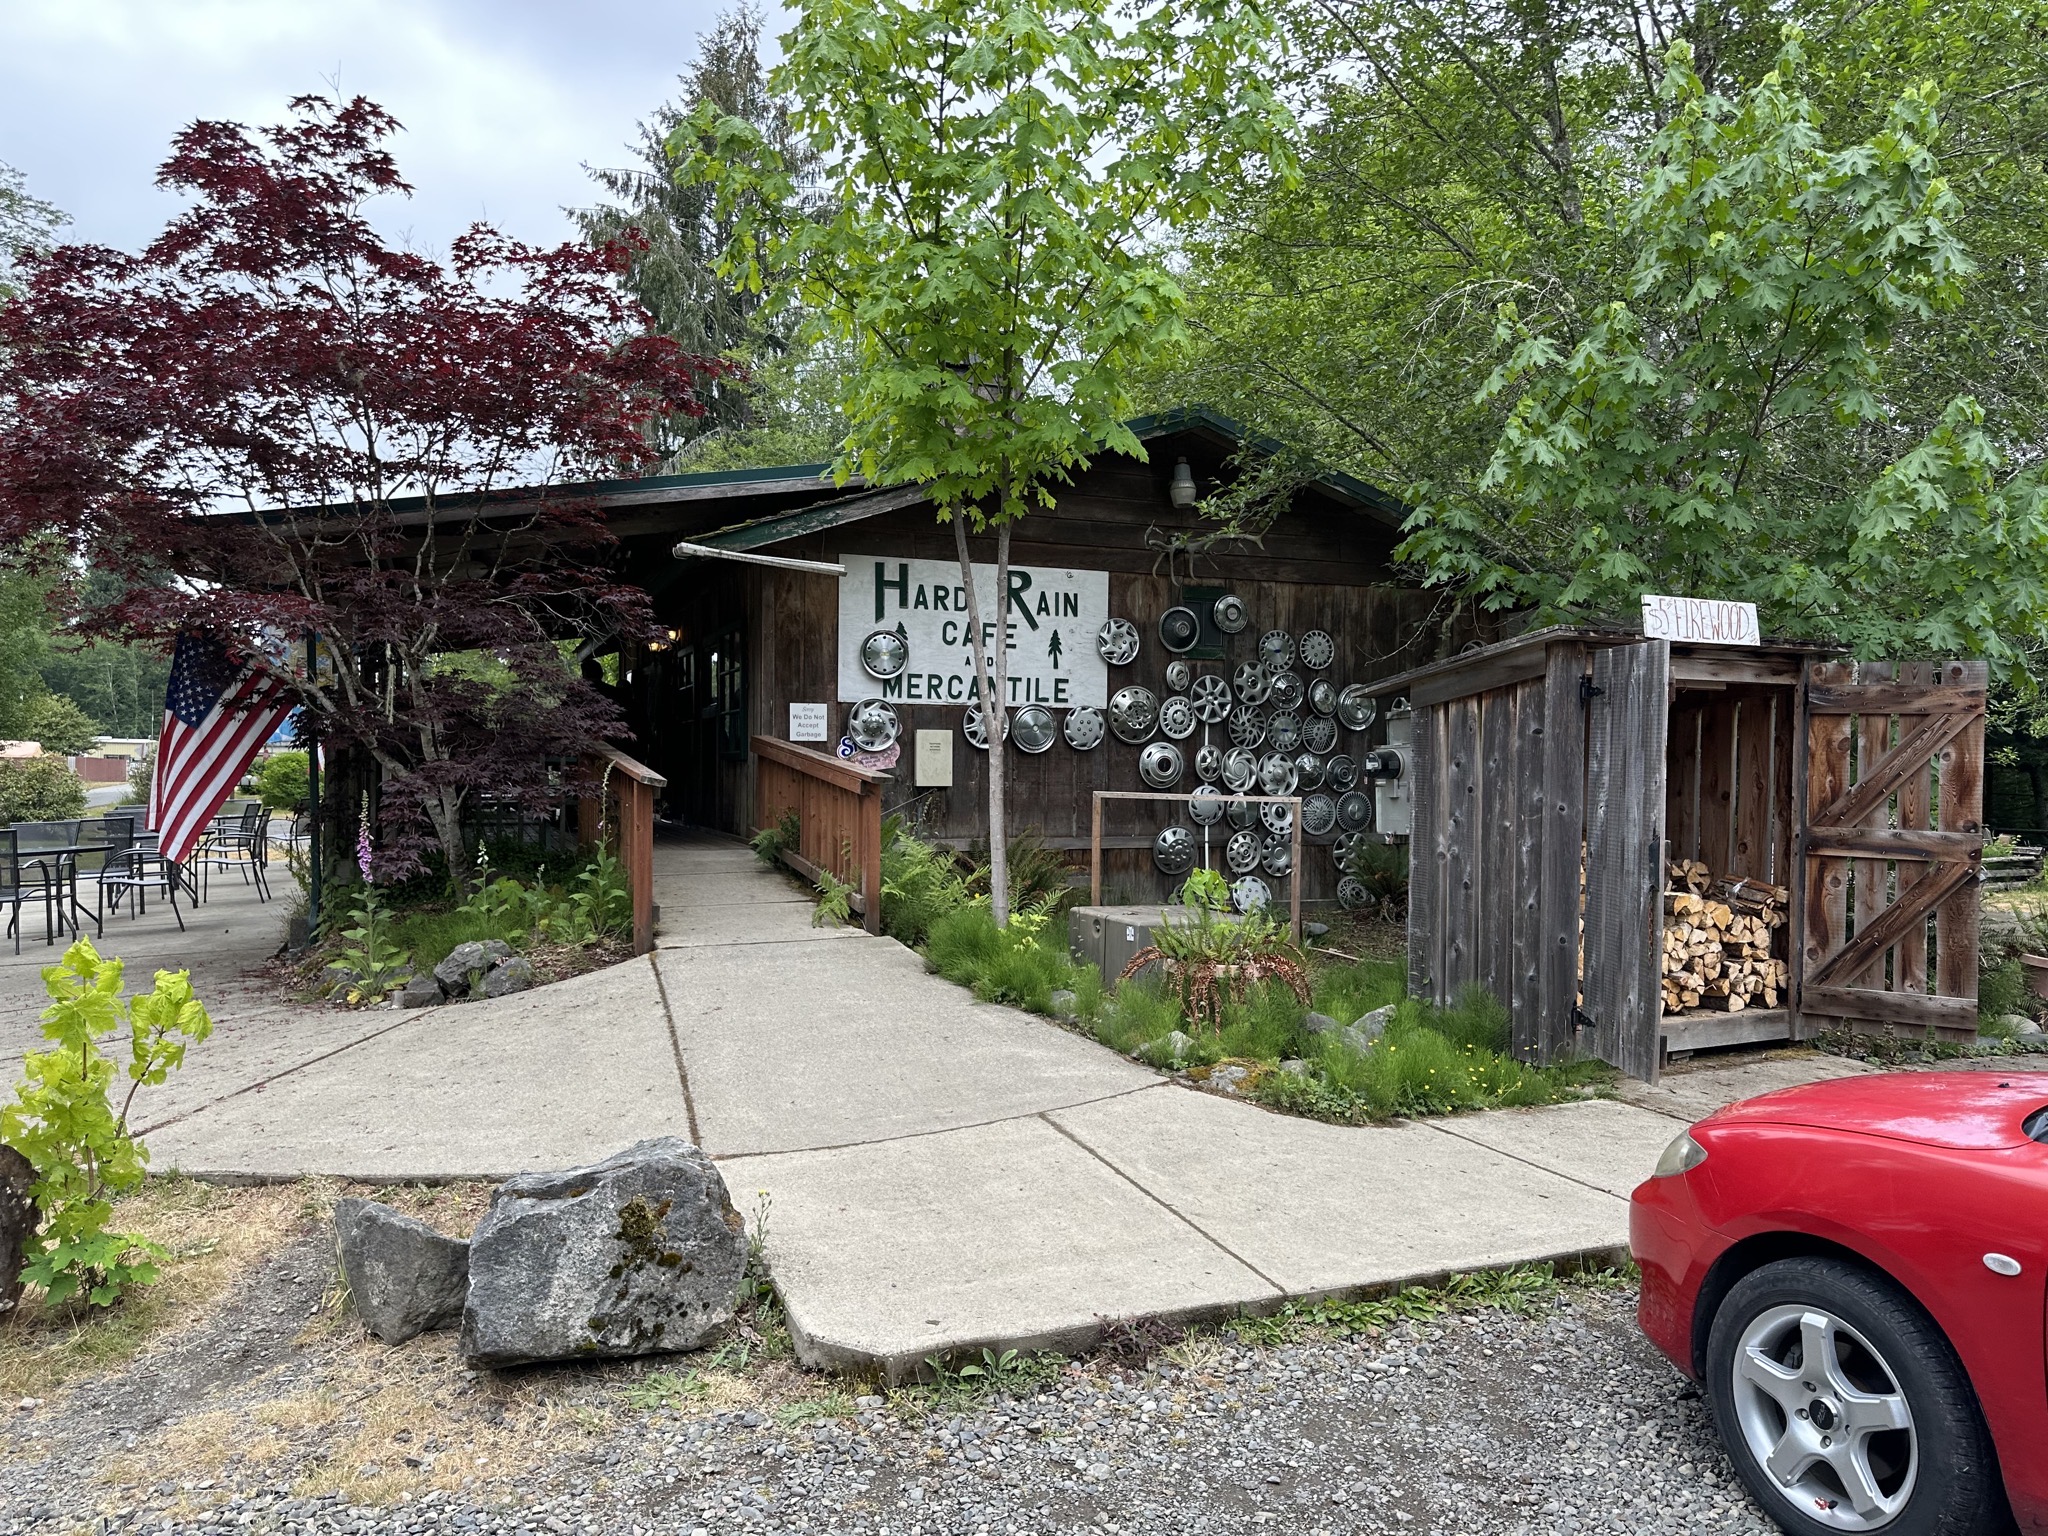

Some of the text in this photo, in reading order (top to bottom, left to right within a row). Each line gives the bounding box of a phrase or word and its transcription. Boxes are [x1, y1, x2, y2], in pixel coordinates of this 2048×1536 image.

[875, 562, 1078, 631] HARD RAIN
[942, 620, 1017, 649] CAFE
[1674, 599, 1750, 640] FIREWOOD
[964, 655, 994, 667] AD
